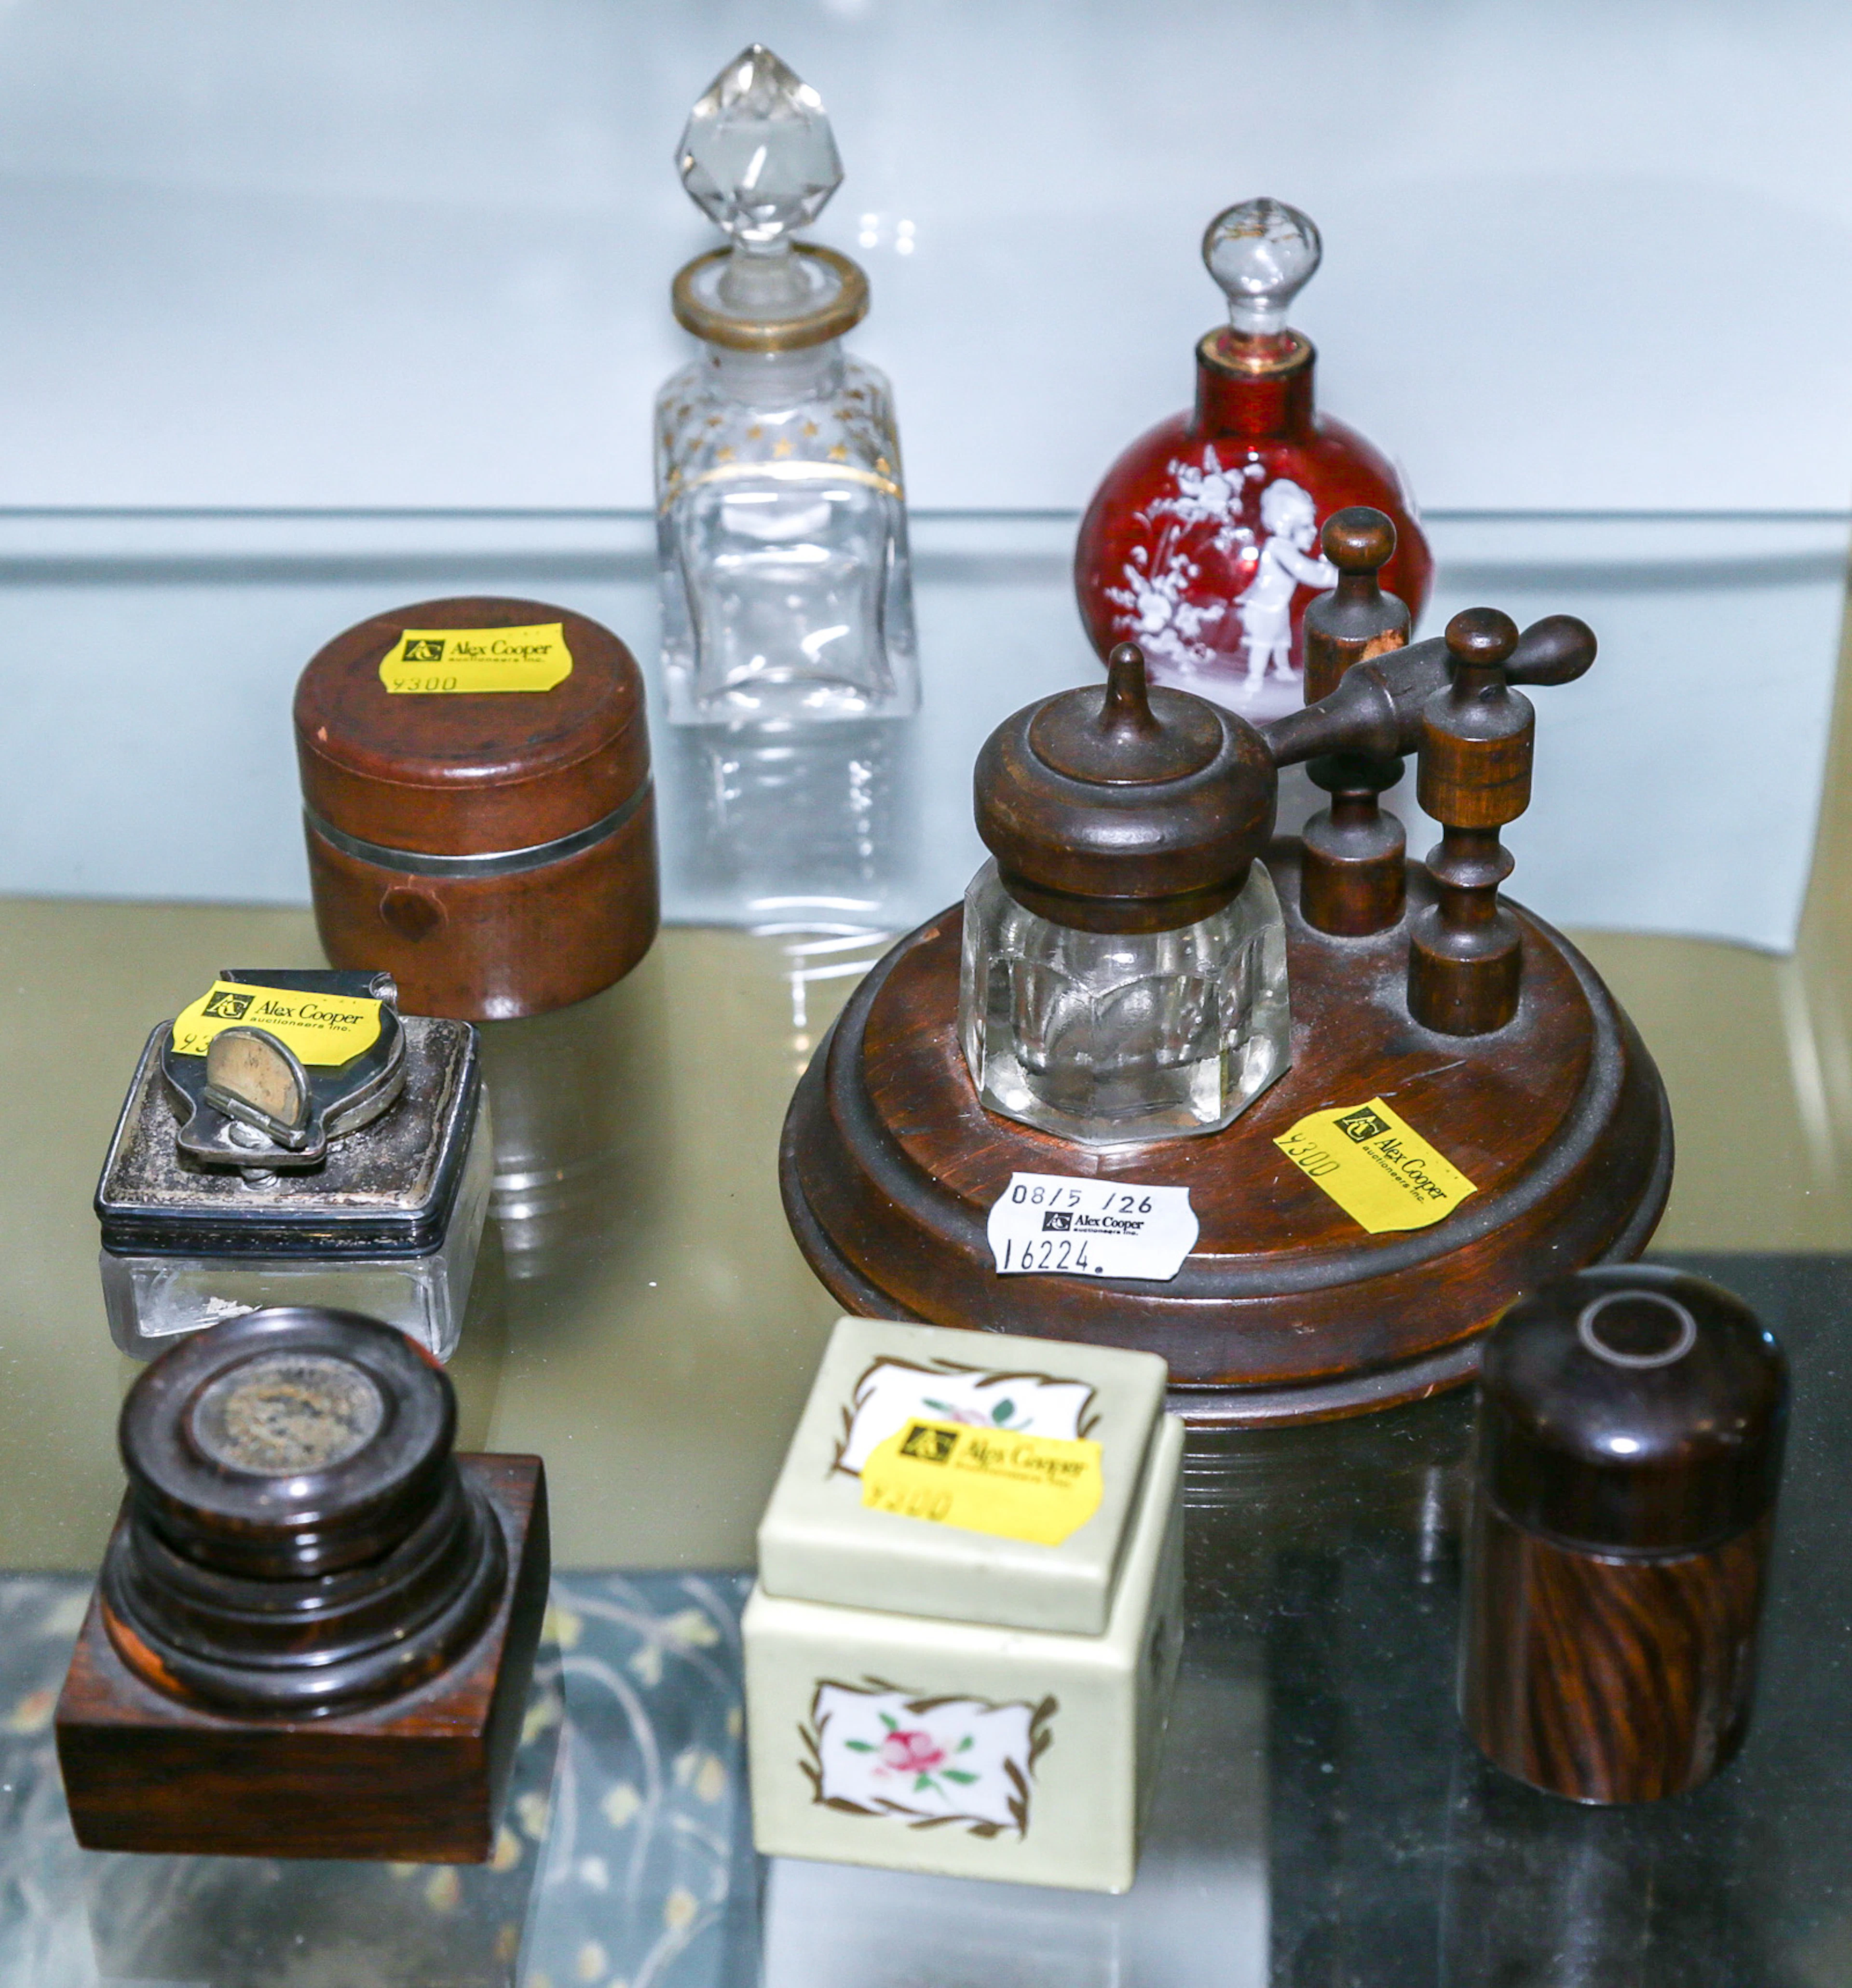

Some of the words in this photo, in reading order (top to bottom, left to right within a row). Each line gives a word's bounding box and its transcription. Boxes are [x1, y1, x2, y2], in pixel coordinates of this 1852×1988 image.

[450, 641, 487, 656] Alex
[491, 640, 552, 659] Cooper
[393, 676, 457, 690] 9300
[250, 1016, 324, 1028] auctioneers
[255, 1001, 296, 1017] Alex
[300, 1004, 364, 1025] Cooper
[180, 1033, 212, 1052] 93
[1279, 1133, 1340, 1176] 9300
[1362, 1146, 1409, 1188] auctioneers
[1374, 1138, 1407, 1163] Alex
[1402, 1159, 1447, 1199] Cooper
[1075, 1215, 1101, 1226] Alex
[1103, 1217, 1144, 1231] Cooper
